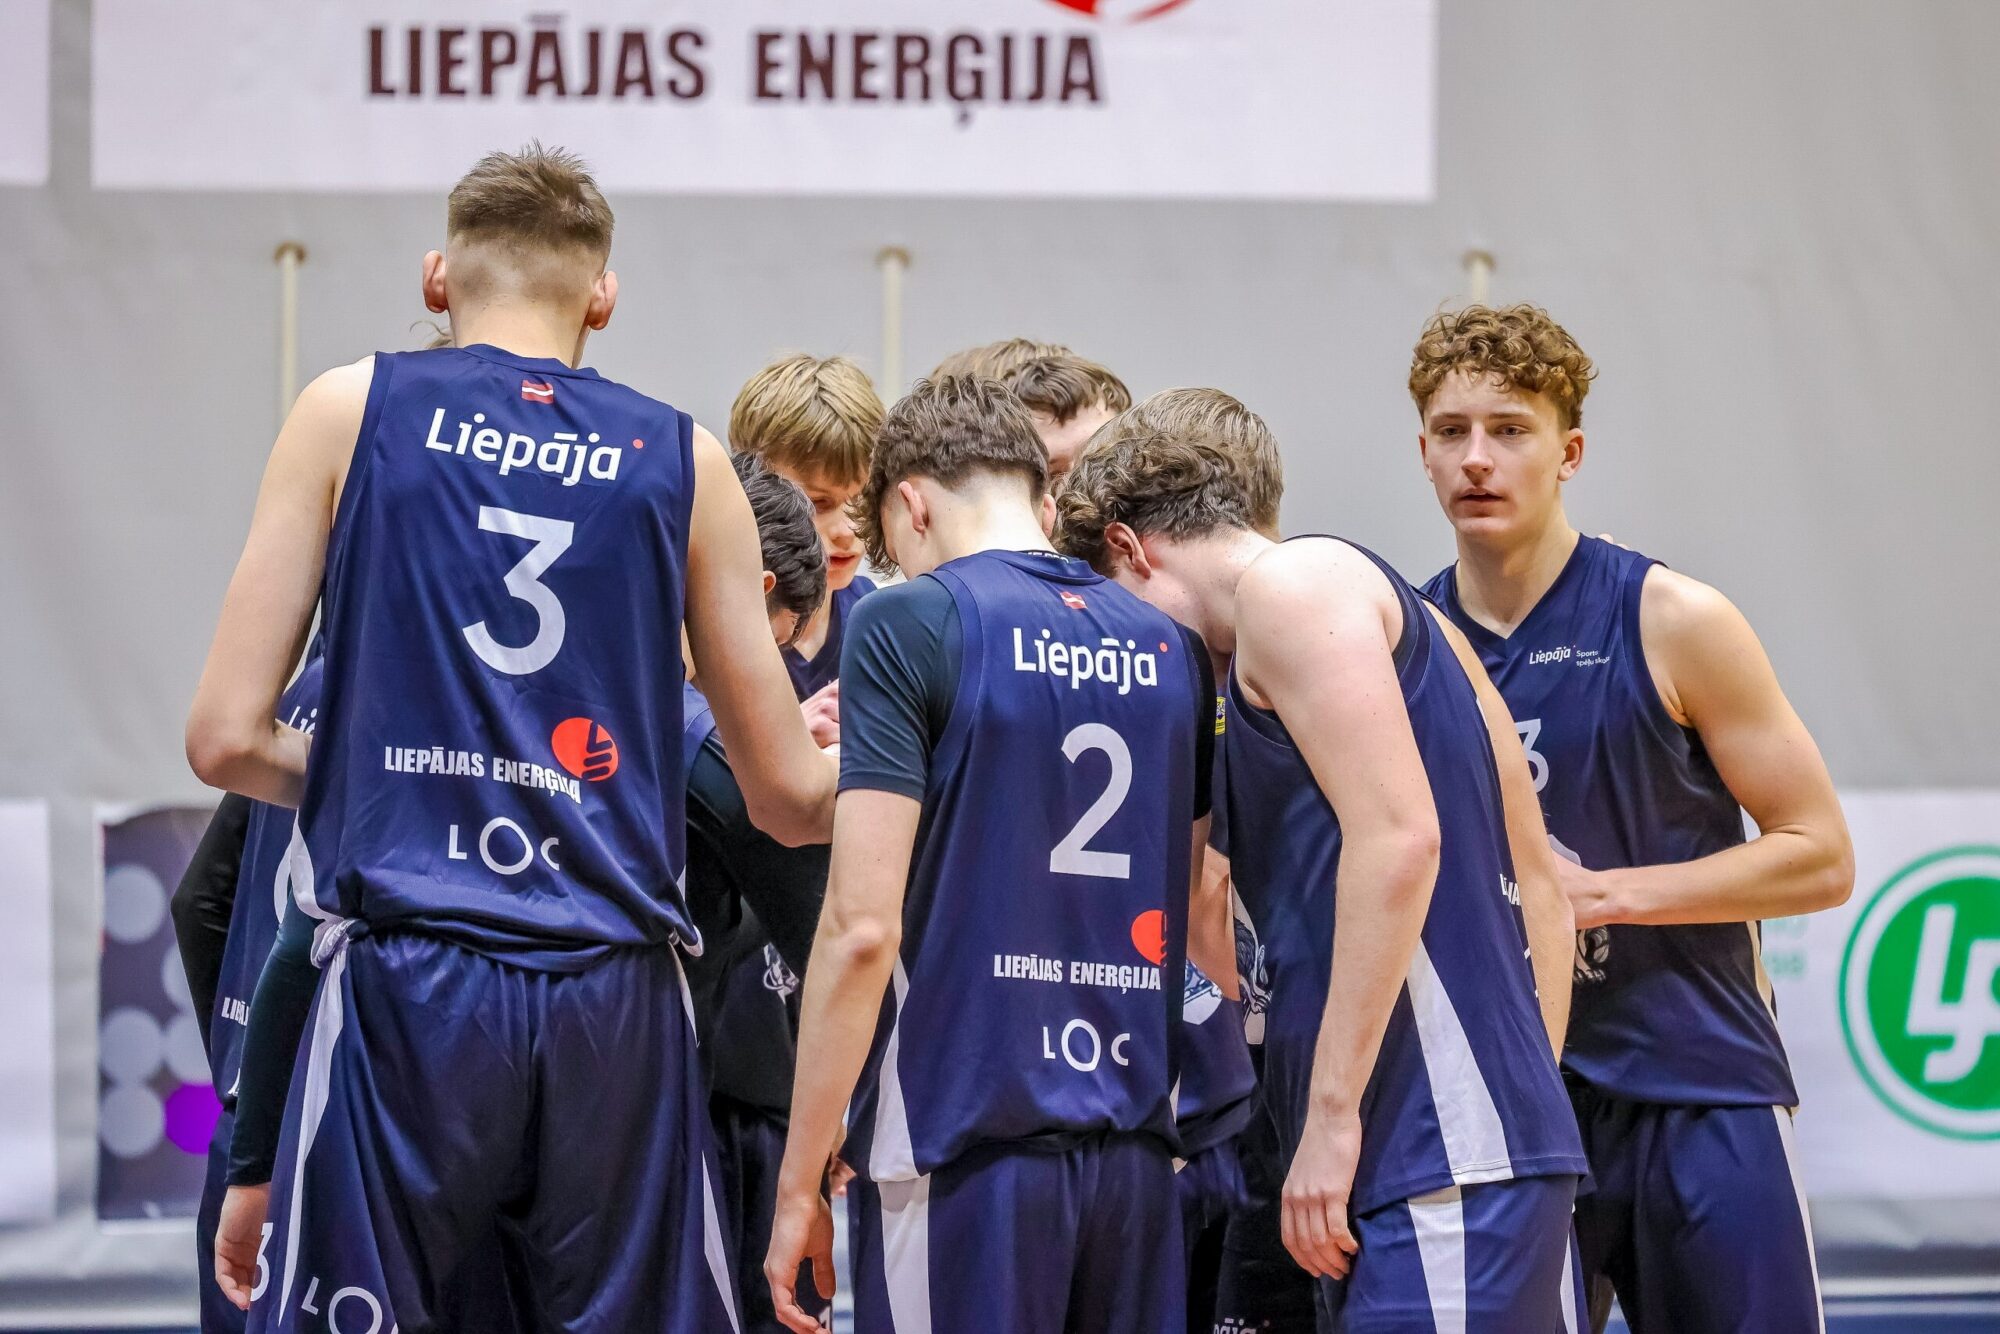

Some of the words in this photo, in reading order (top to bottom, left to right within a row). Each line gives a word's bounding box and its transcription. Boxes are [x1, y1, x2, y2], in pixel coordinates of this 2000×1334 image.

[366, 16, 708, 101] LIEPĀJAS
[754, 31, 1106, 126] ENERĢIJA
[425, 407, 623, 487] Liepāja
[462, 505, 575, 676] 3
[1013, 627, 1158, 696] Liepāja
[1529, 646, 1571, 665] Liepāja
[384, 746, 485, 778] LIEPĀJAS
[493, 757, 582, 804] ENERĢIJA
[1049, 722, 1133, 879] 2
[448, 816, 560, 875] LOC
[993, 953, 1063, 983] LIEPĀJAS
[1070, 961, 1161, 995] ENERĢIJA
[1042, 1018, 1131, 1072] LOC
[301, 1276, 399, 1334] LO
